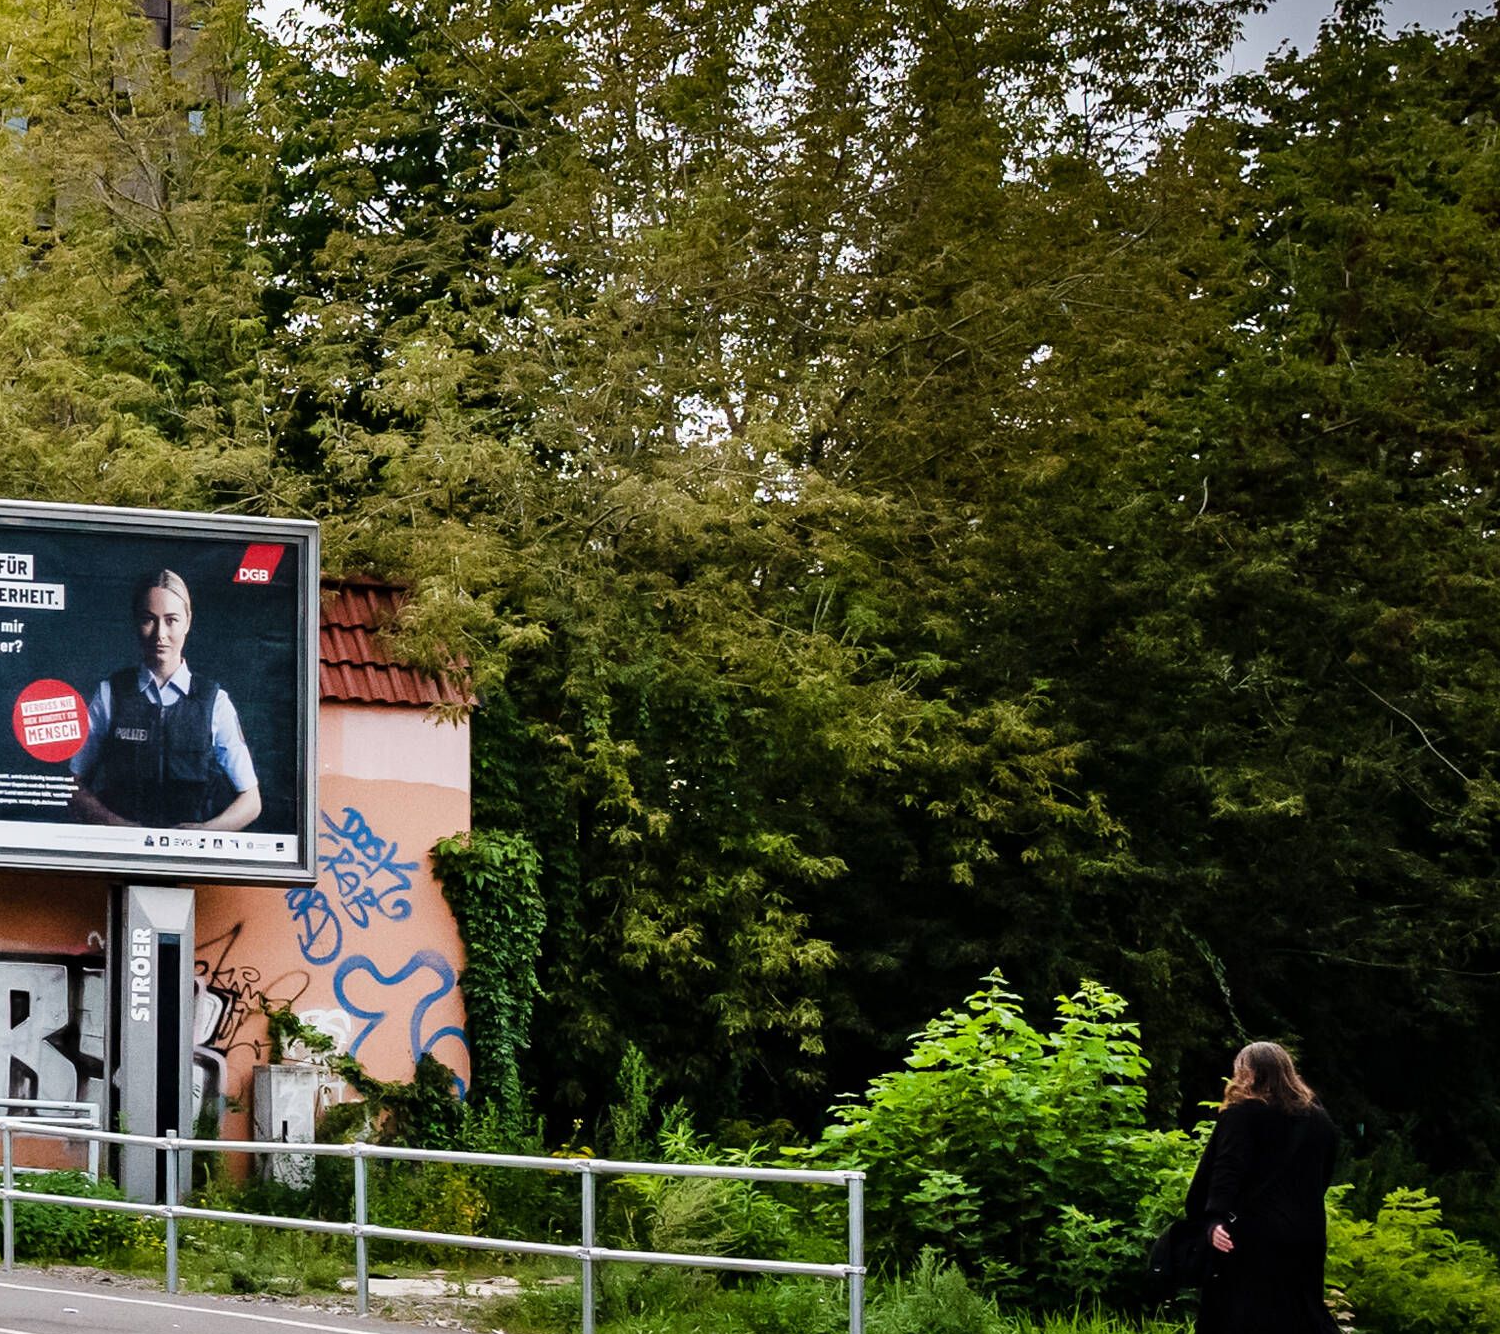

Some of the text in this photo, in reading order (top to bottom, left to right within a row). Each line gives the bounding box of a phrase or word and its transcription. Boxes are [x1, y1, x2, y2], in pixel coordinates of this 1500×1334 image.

[239, 568, 269, 582] DGB
[1, 619, 25, 633] mir
[28, 723, 78, 742] MENSCH
